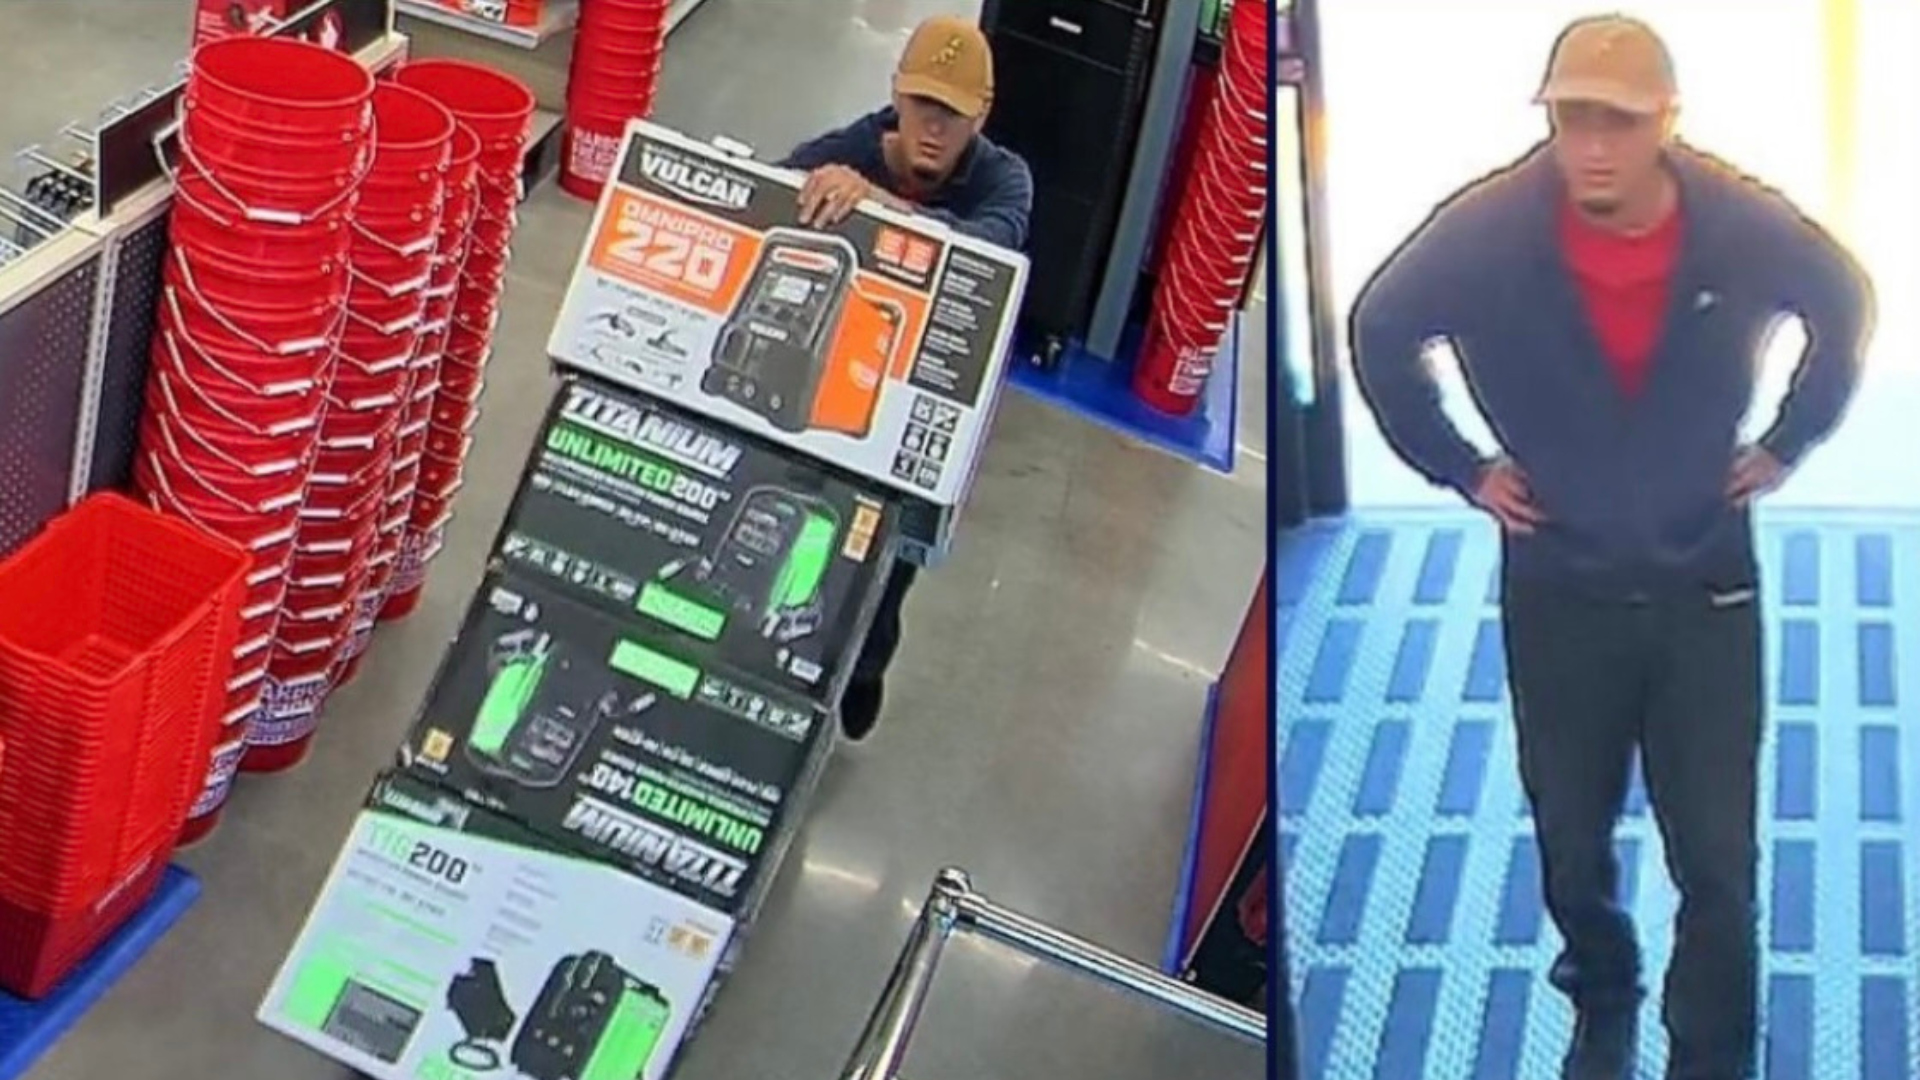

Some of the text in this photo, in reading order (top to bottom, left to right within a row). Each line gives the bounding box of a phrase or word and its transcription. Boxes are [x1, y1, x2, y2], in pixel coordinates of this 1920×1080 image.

[641, 152, 753, 206] VULCAN
[606, 220, 730, 292] 220
[623, 202, 736, 251] OMNIPRO
[547, 427, 672, 490] UNLIMITED
[563, 388, 742, 472] TITANIUM
[563, 799, 748, 897] TITANIUM
[632, 777, 762, 854] UNLIMITED
